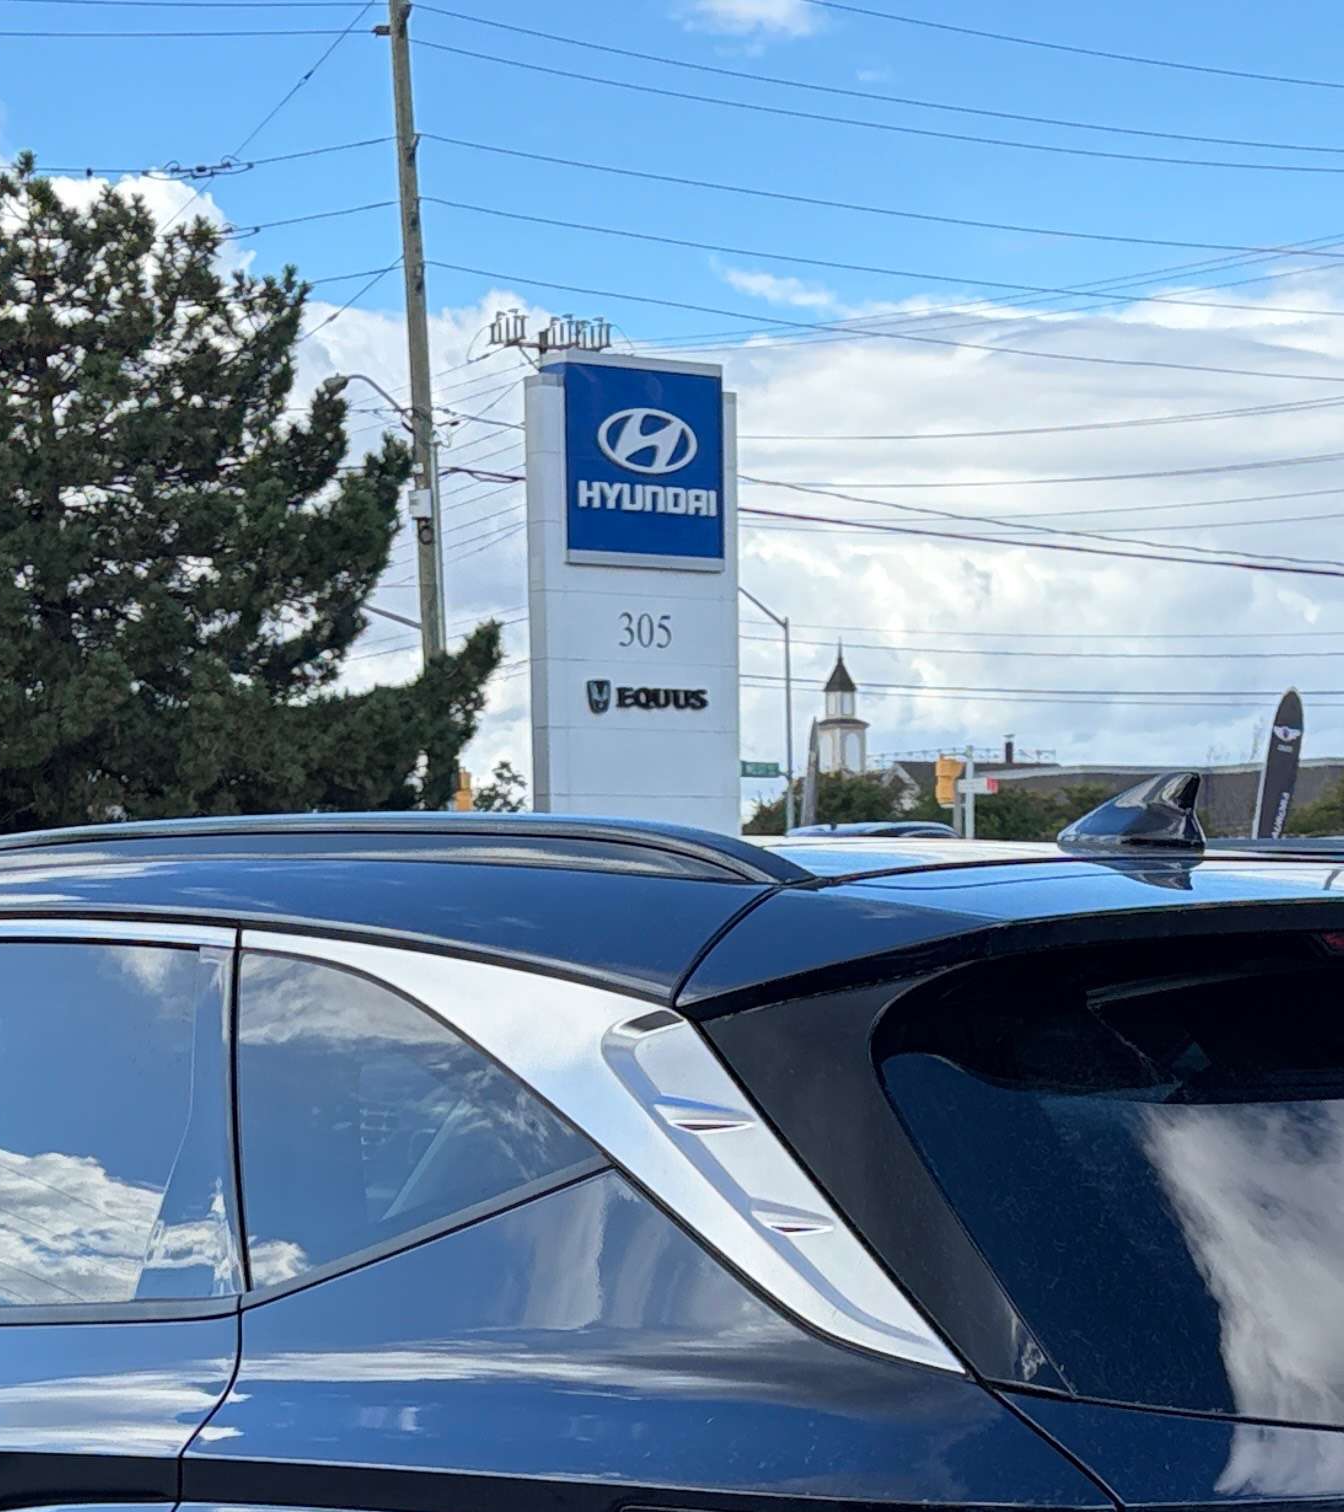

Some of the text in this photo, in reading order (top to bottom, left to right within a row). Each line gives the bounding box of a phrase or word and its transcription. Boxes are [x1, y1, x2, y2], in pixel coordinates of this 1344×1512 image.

[577, 479, 719, 518] HYUNDAI
[618, 611, 673, 649] 305
[615, 685, 710, 711] EQUUS
